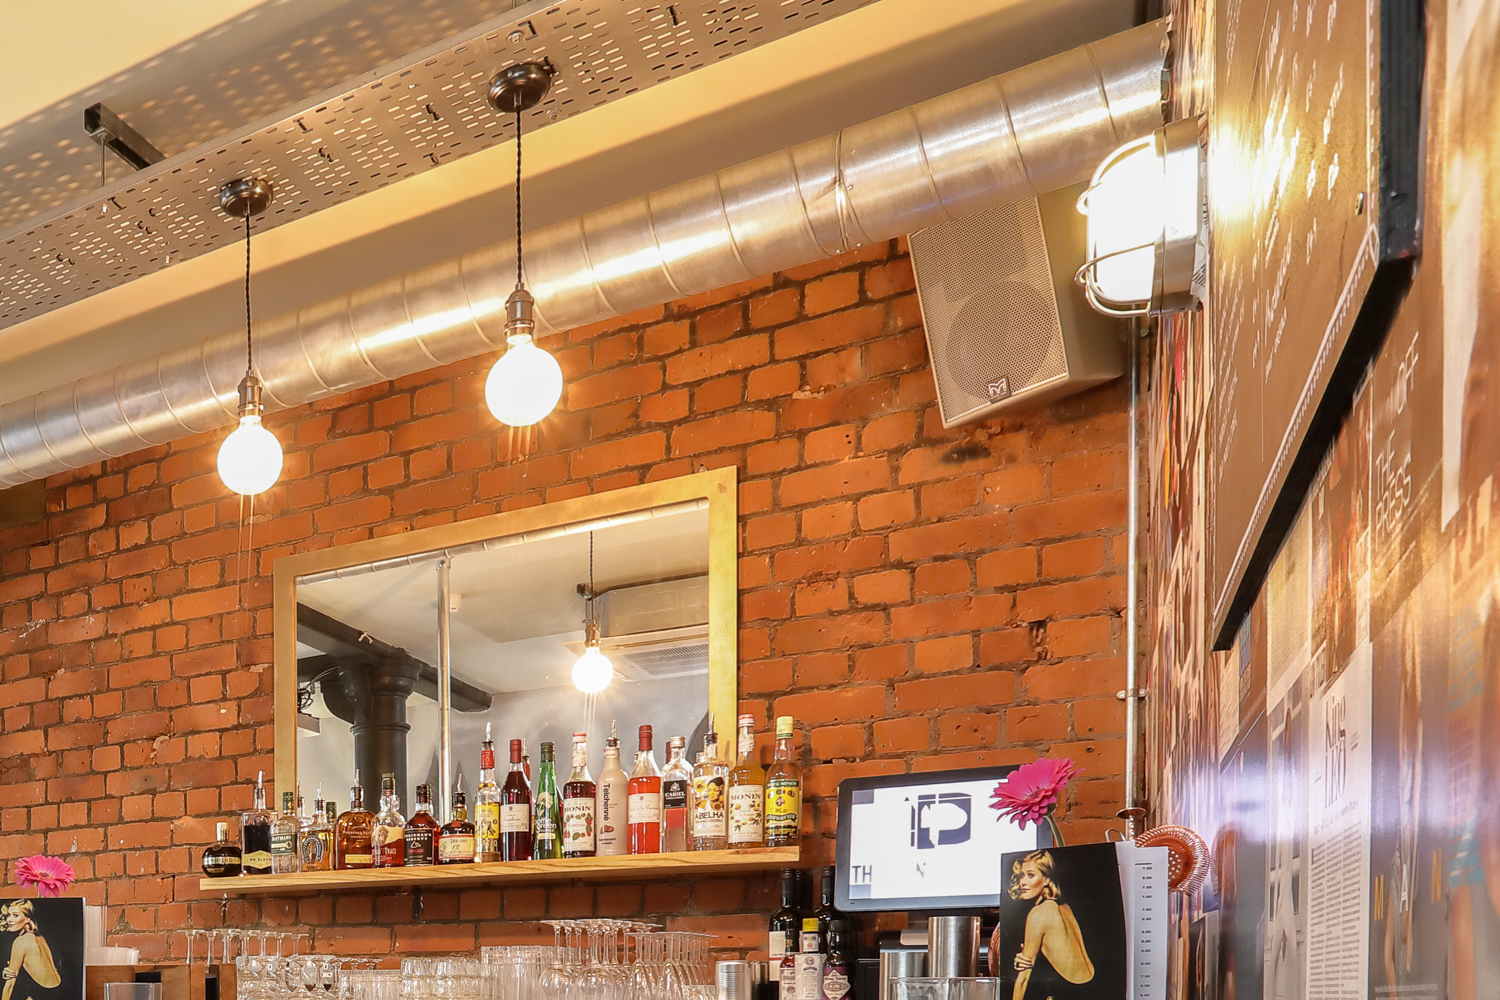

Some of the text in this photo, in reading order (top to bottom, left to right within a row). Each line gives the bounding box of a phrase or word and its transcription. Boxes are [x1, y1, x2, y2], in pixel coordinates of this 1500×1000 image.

[1396, 331, 1419, 415] OFF
[1375, 428, 1396, 502] THE
[1375, 452, 1412, 551] PRESS
[695, 811, 724, 820] ABELHA
